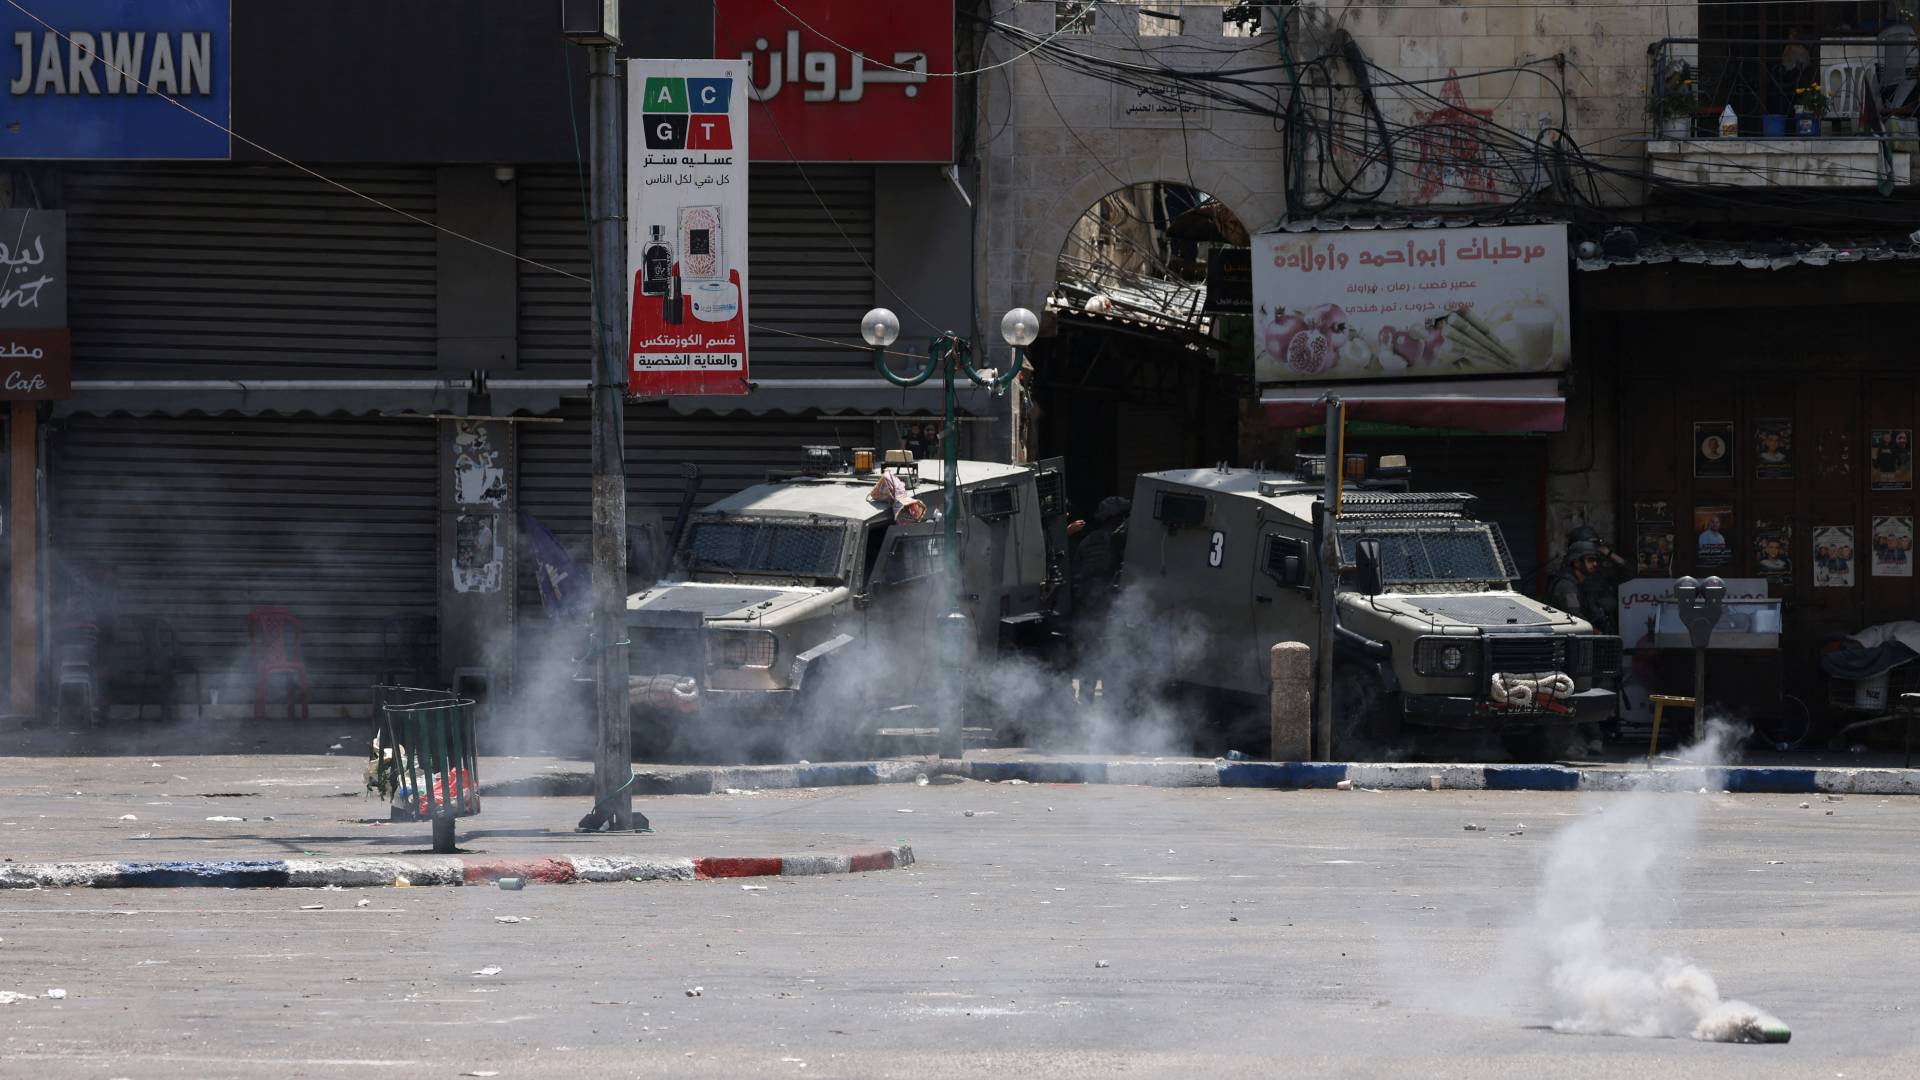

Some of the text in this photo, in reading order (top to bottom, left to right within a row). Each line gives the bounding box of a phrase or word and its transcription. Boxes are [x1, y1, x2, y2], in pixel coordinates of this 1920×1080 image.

[10, 31, 211, 95] JARWAN
[741, 30, 928, 102] جروان
[657, 86, 716, 104] A C
[656, 122, 716, 141] G T
[643, 153, 733, 168] عسليه سنتر
[645, 174, 730, 189] كل شي لكل الناس
[1456, 236, 1546, 264] مرطبات
[1386, 281, 1410, 293] رمان
[1418, 279, 1448, 290] قصب
[1450, 279, 1477, 291] عصير
[1380, 302, 1397, 314] تمر
[1405, 302, 1436, 313] خروب
[639, 334, 736, 349] قسم الكوزمتكس
[638, 354, 738, 369] والعناية الشخصية
[5, 371, 47, 392] Cafe
[1209, 531, 1223, 566] 3
